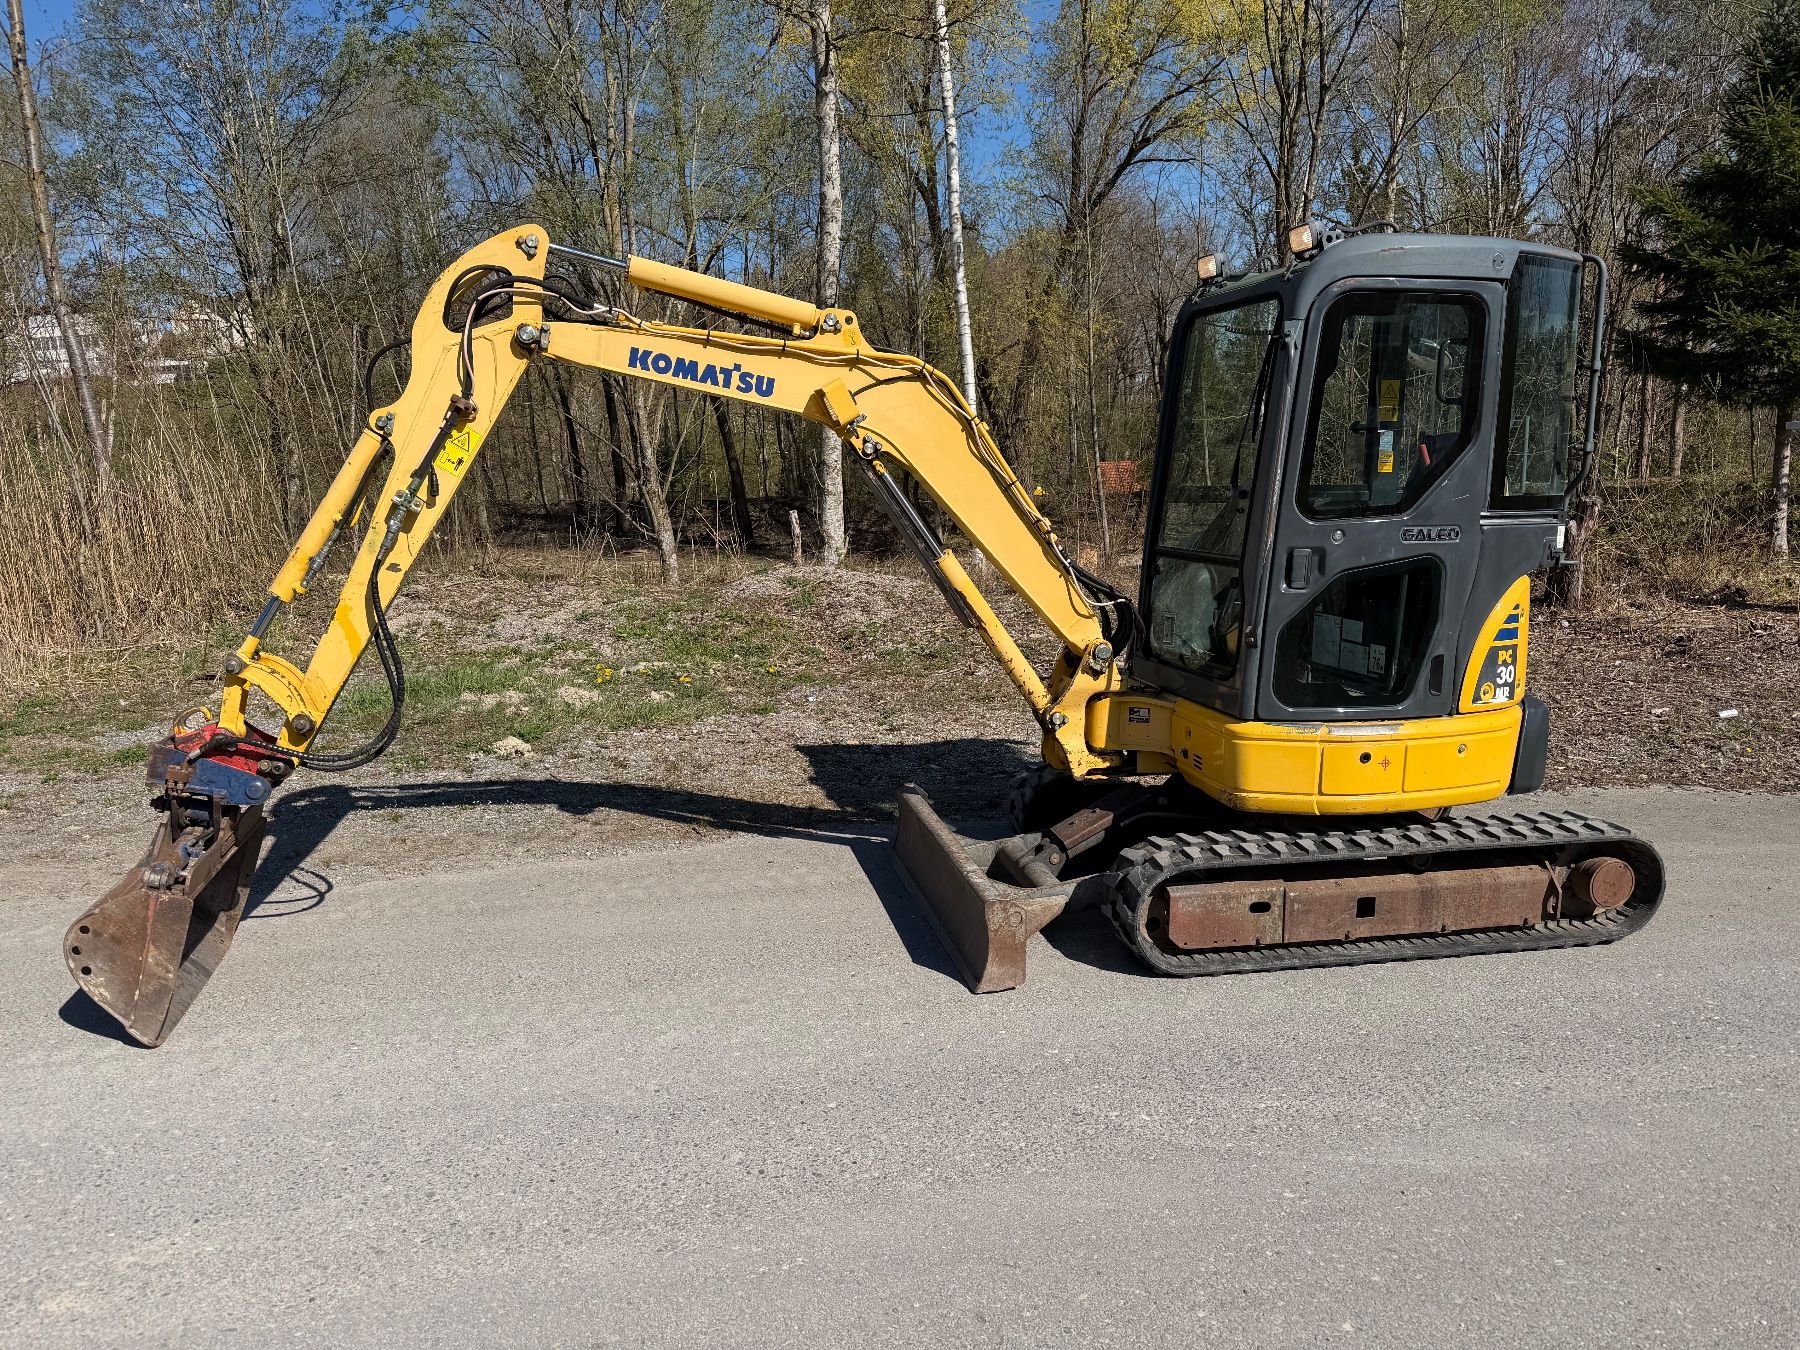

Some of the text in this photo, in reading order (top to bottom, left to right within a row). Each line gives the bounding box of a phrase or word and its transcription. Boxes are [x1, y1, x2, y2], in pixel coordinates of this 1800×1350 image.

[628, 347, 775, 397] KOMATSU
[1401, 528, 1460, 541] GALEO
[1498, 649, 1513, 664] PC
[1496, 665, 1515, 684] 30
[1495, 687, 1510, 698] MR
